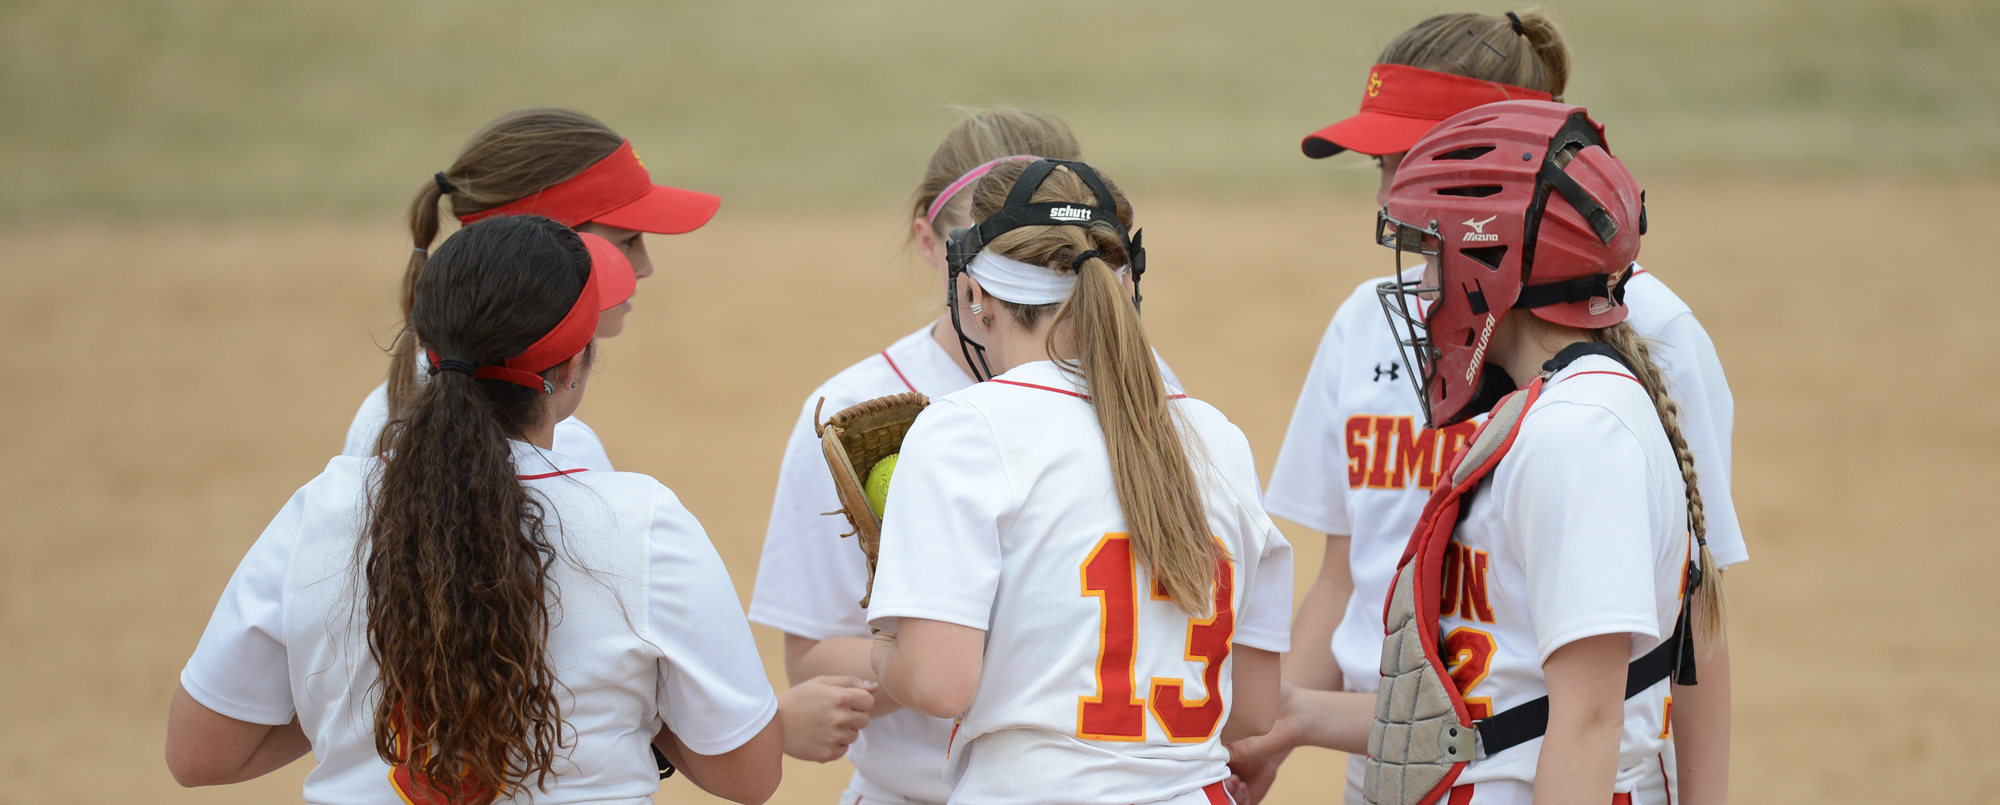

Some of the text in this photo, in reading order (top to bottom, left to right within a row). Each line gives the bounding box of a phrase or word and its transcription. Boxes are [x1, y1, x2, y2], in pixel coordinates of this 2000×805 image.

[1050, 205, 1091, 219] schutt
[1465, 313, 1496, 386] SAMURAI
[1075, 532, 1235, 743] 13
